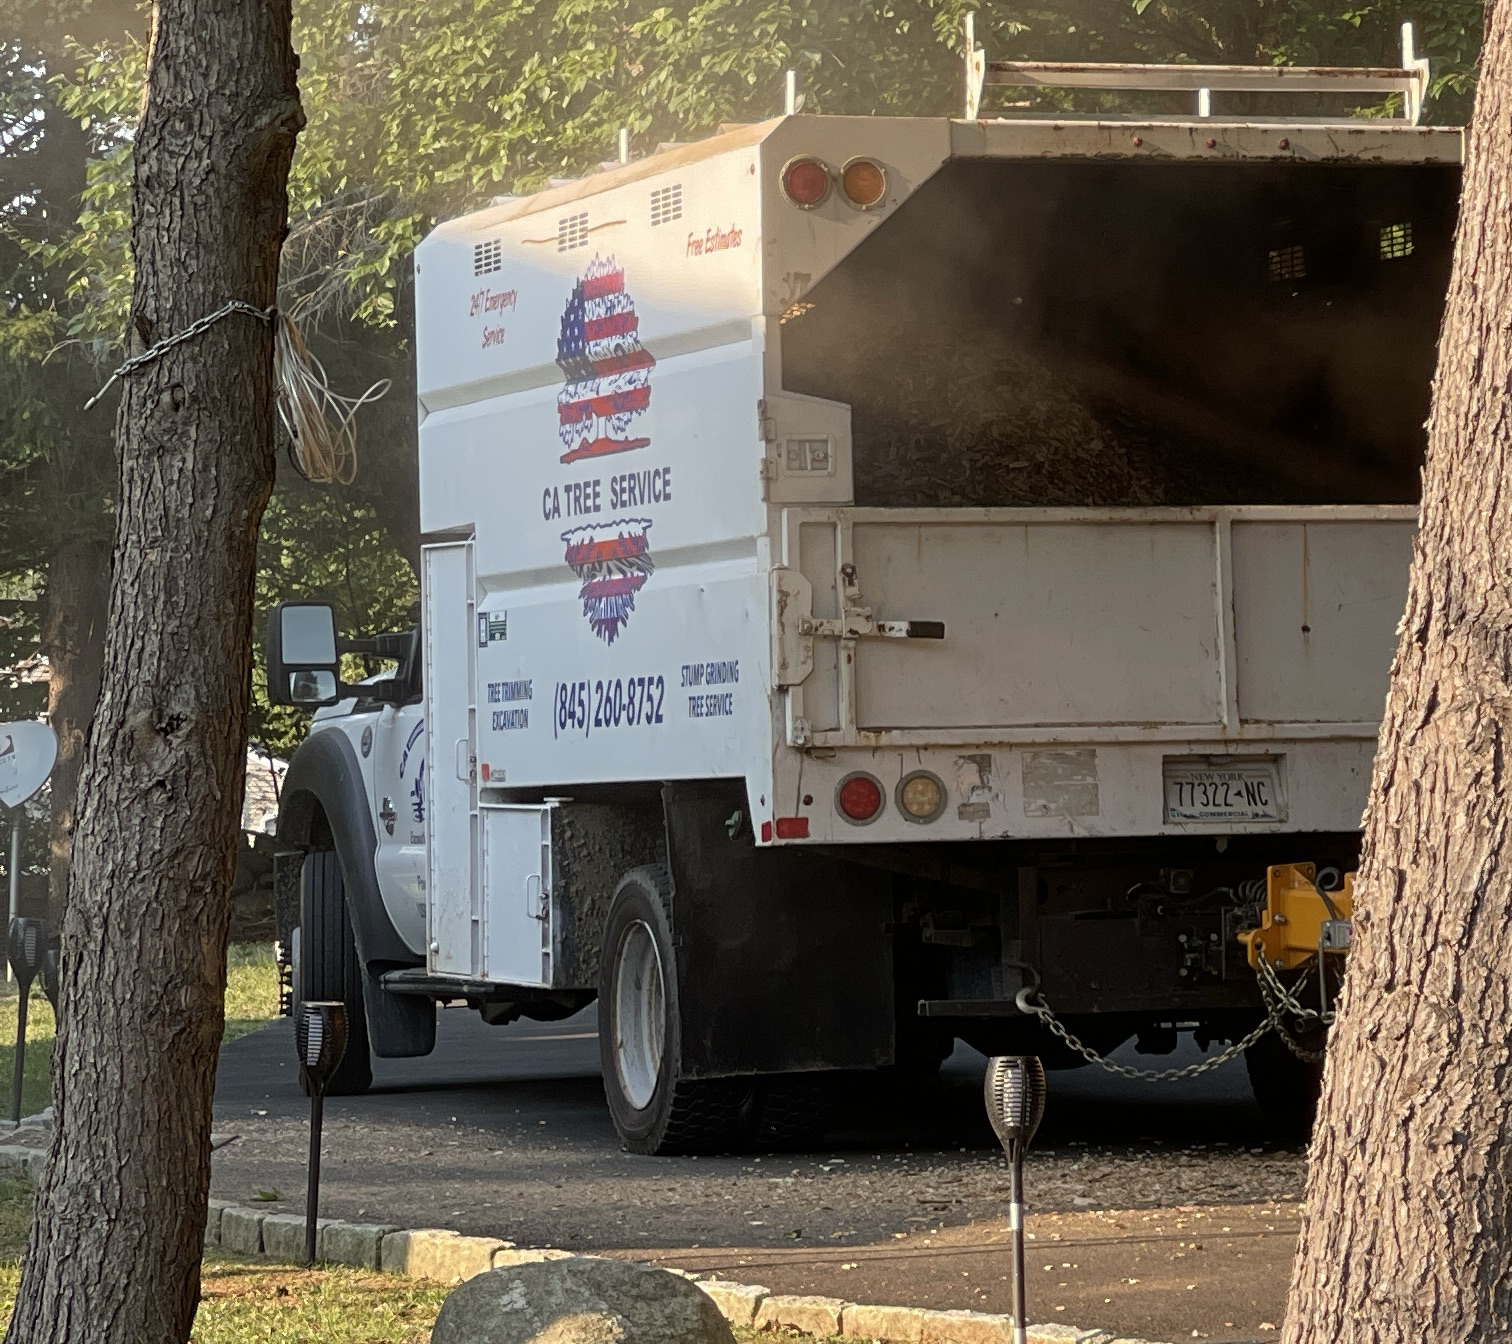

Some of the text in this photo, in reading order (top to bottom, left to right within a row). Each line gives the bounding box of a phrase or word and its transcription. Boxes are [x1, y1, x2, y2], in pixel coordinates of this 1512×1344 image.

[686, 222, 743, 258] Free Estimates
[542, 466, 672, 521] CA TREE SERVICE
[681, 659, 740, 687] STUMP GRINDING
[487, 679, 533, 703] TREE TRIMMING
[554, 674, 665, 740] (845) 260-8752
[688, 693, 733, 718] TREE SERVICE
[492, 709, 529, 731] EXCAVATION
[1190, 772, 1246, 782] NEW YORK
